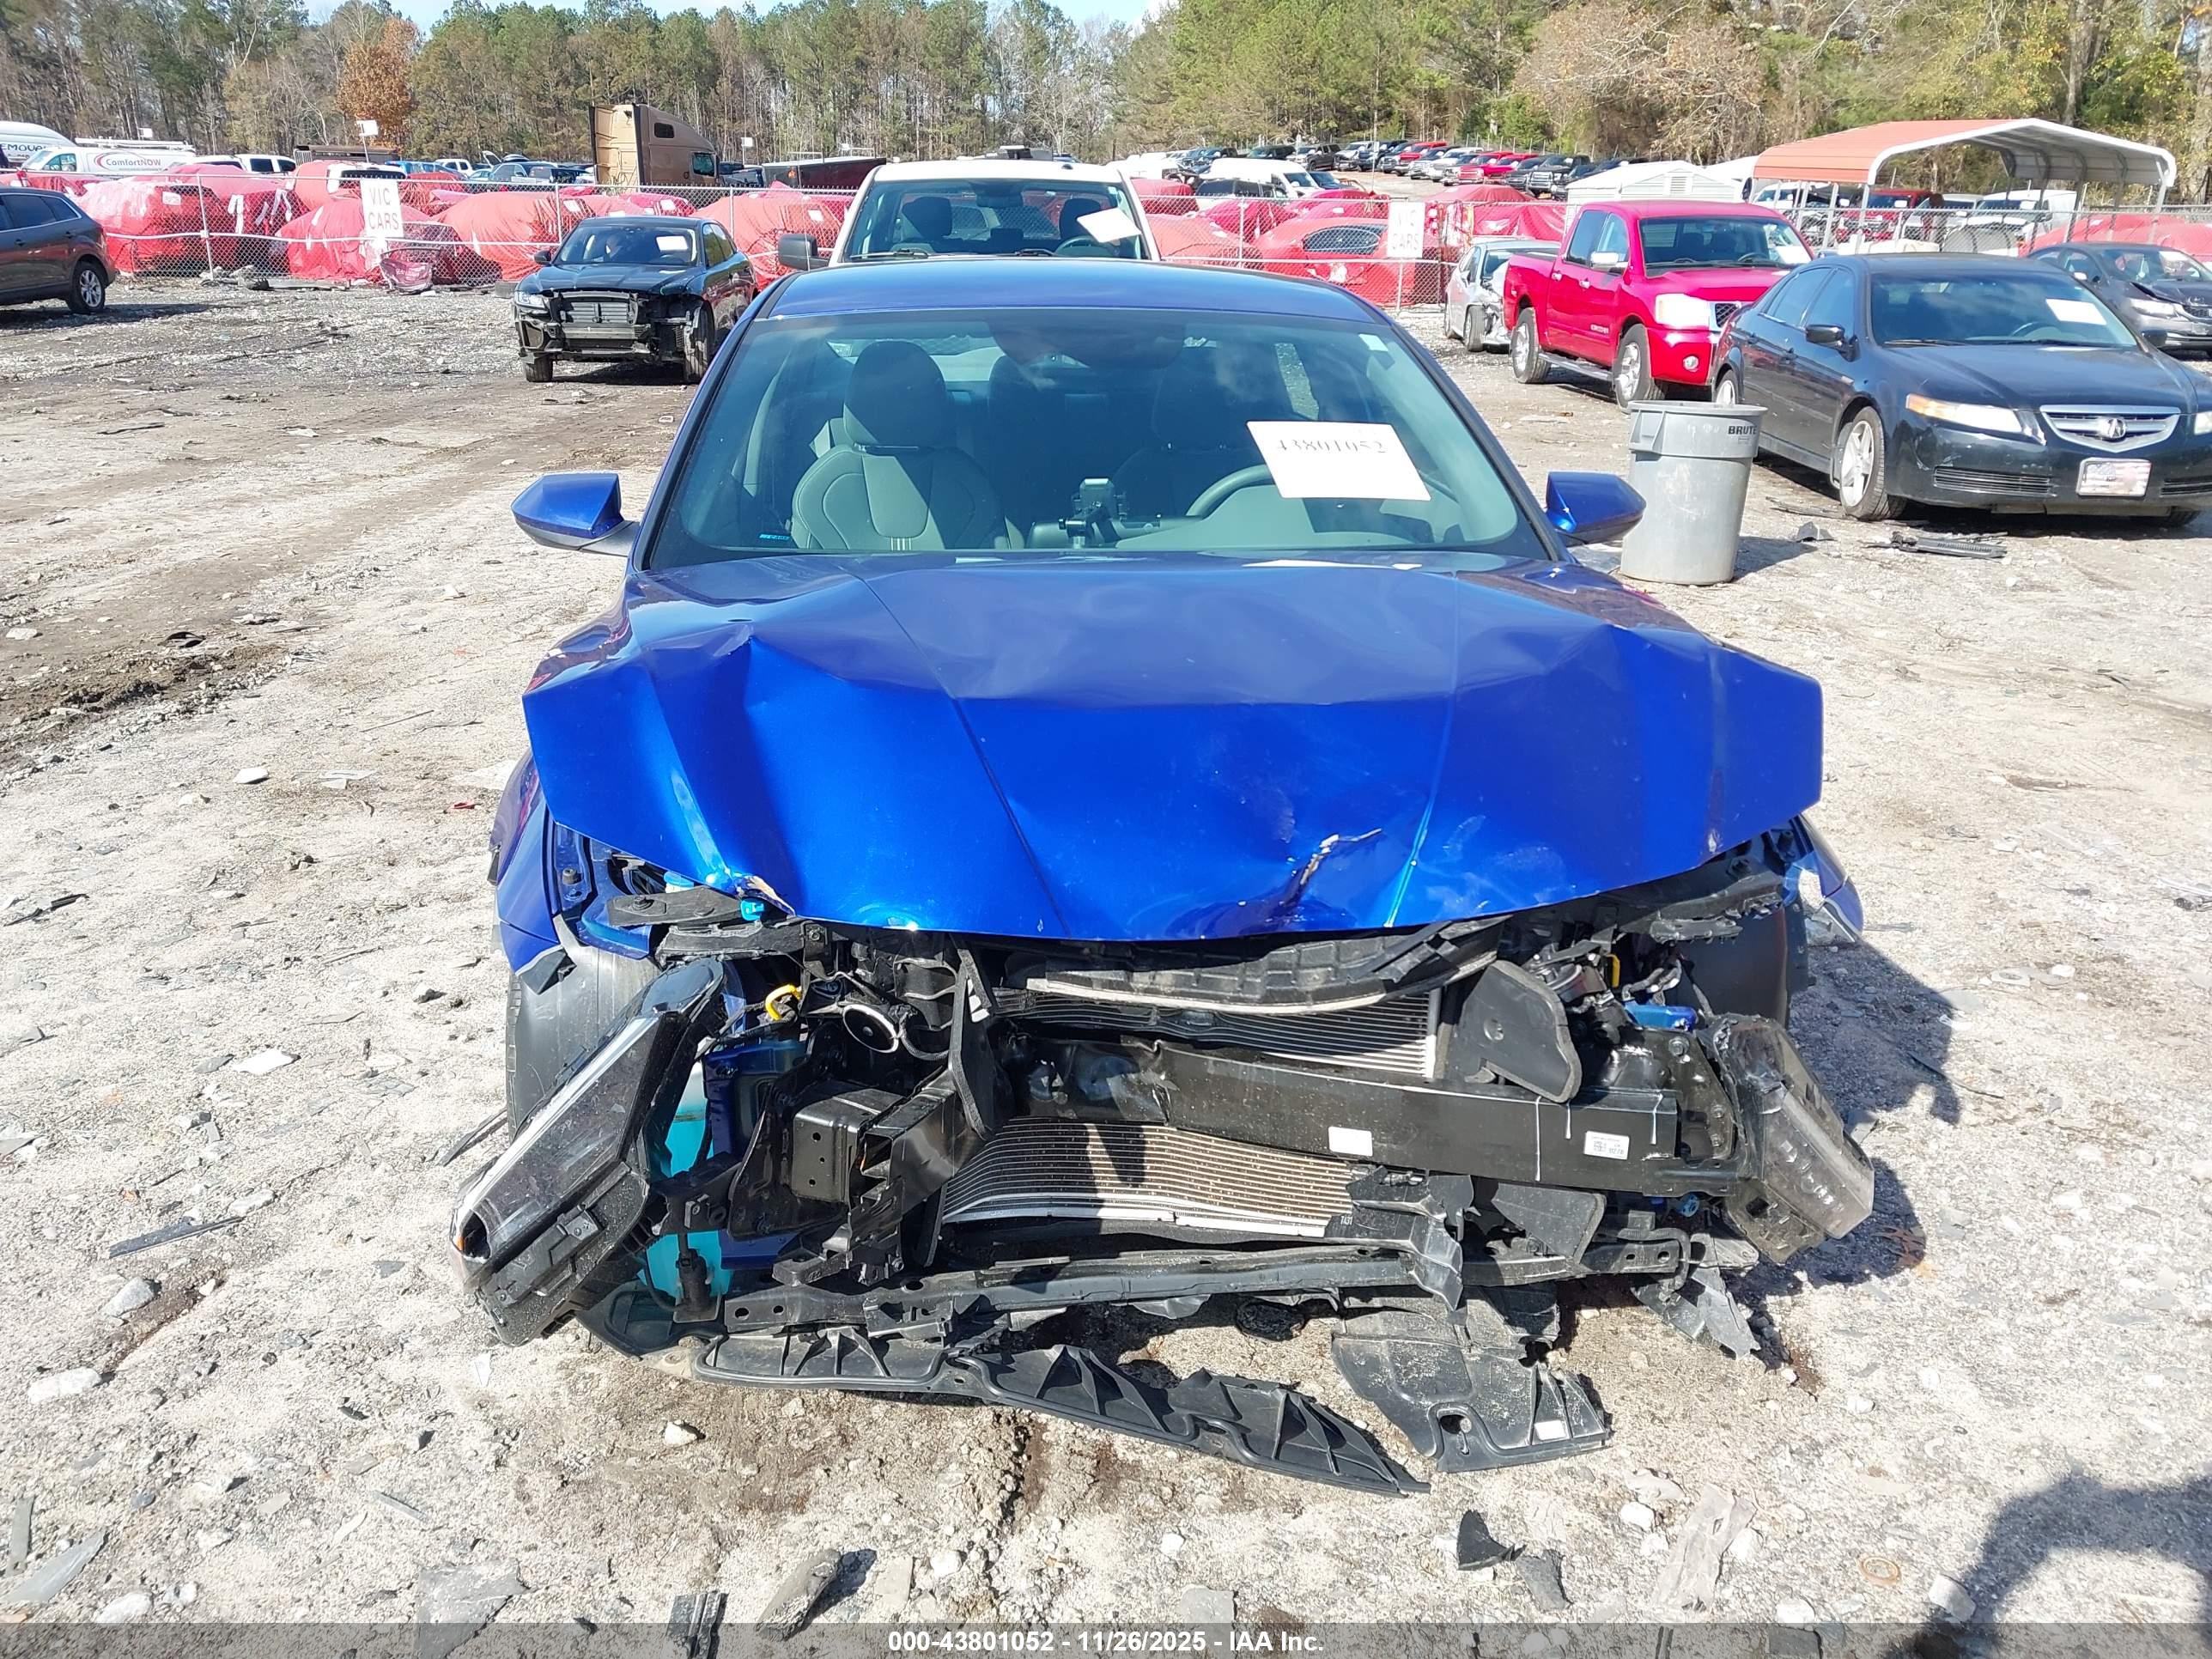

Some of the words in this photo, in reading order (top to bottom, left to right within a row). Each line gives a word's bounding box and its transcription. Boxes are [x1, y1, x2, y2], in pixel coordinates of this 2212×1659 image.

[106, 158, 161, 167] ComfortNOW
[369, 187, 391, 205] VIC
[368, 212, 398, 230] CARS
[1728, 425, 1758, 434] BRUTE
